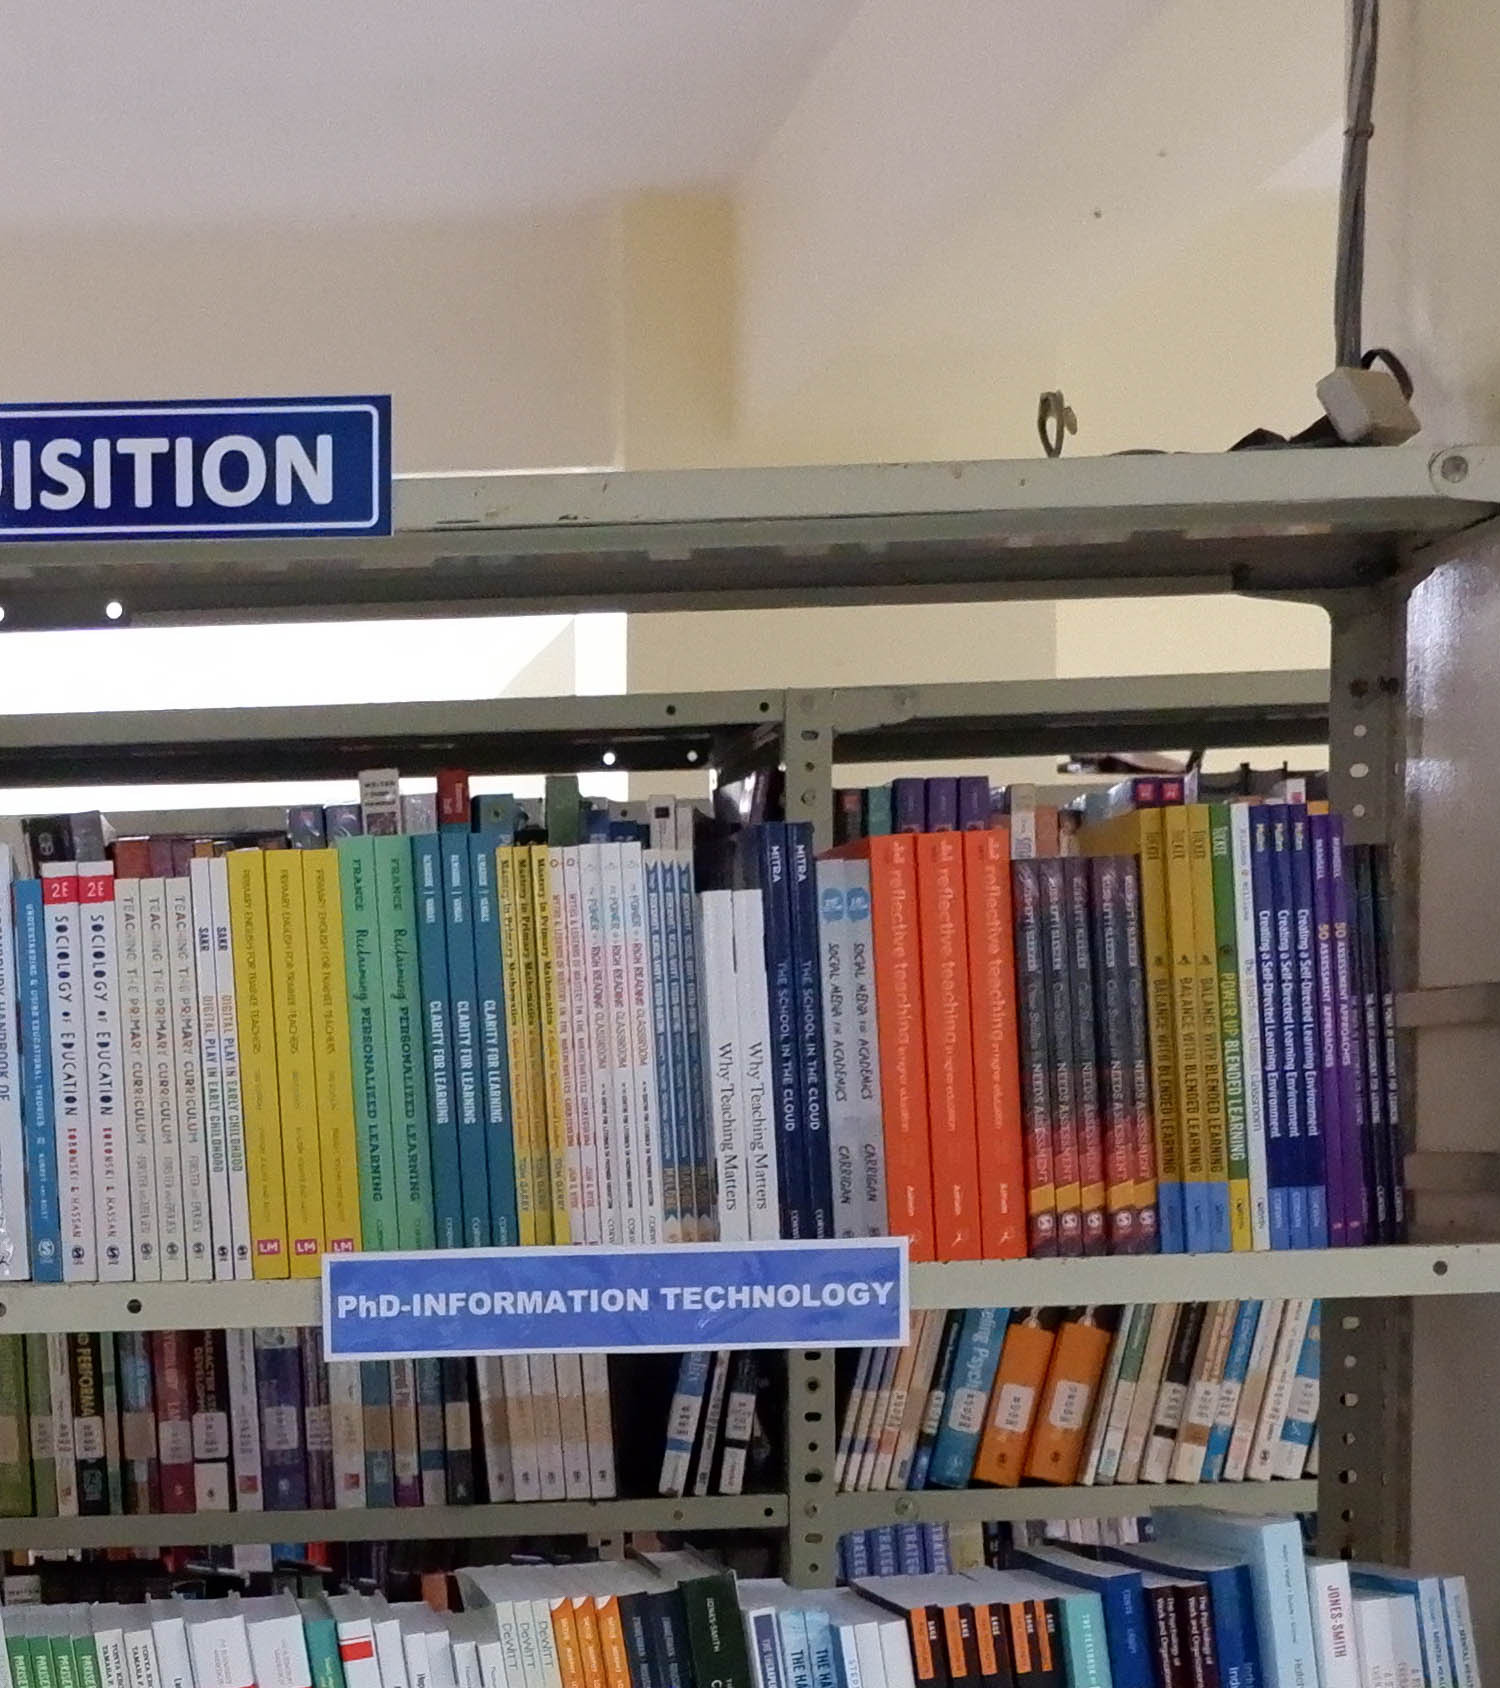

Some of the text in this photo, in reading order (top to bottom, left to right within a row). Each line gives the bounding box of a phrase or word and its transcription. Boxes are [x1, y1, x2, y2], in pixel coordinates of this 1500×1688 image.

[745, 1040, 770, 1209] Why Teaching Matters
[338, 1282, 894, 1318] PhD-INFORMATION TECHNOLOGY
